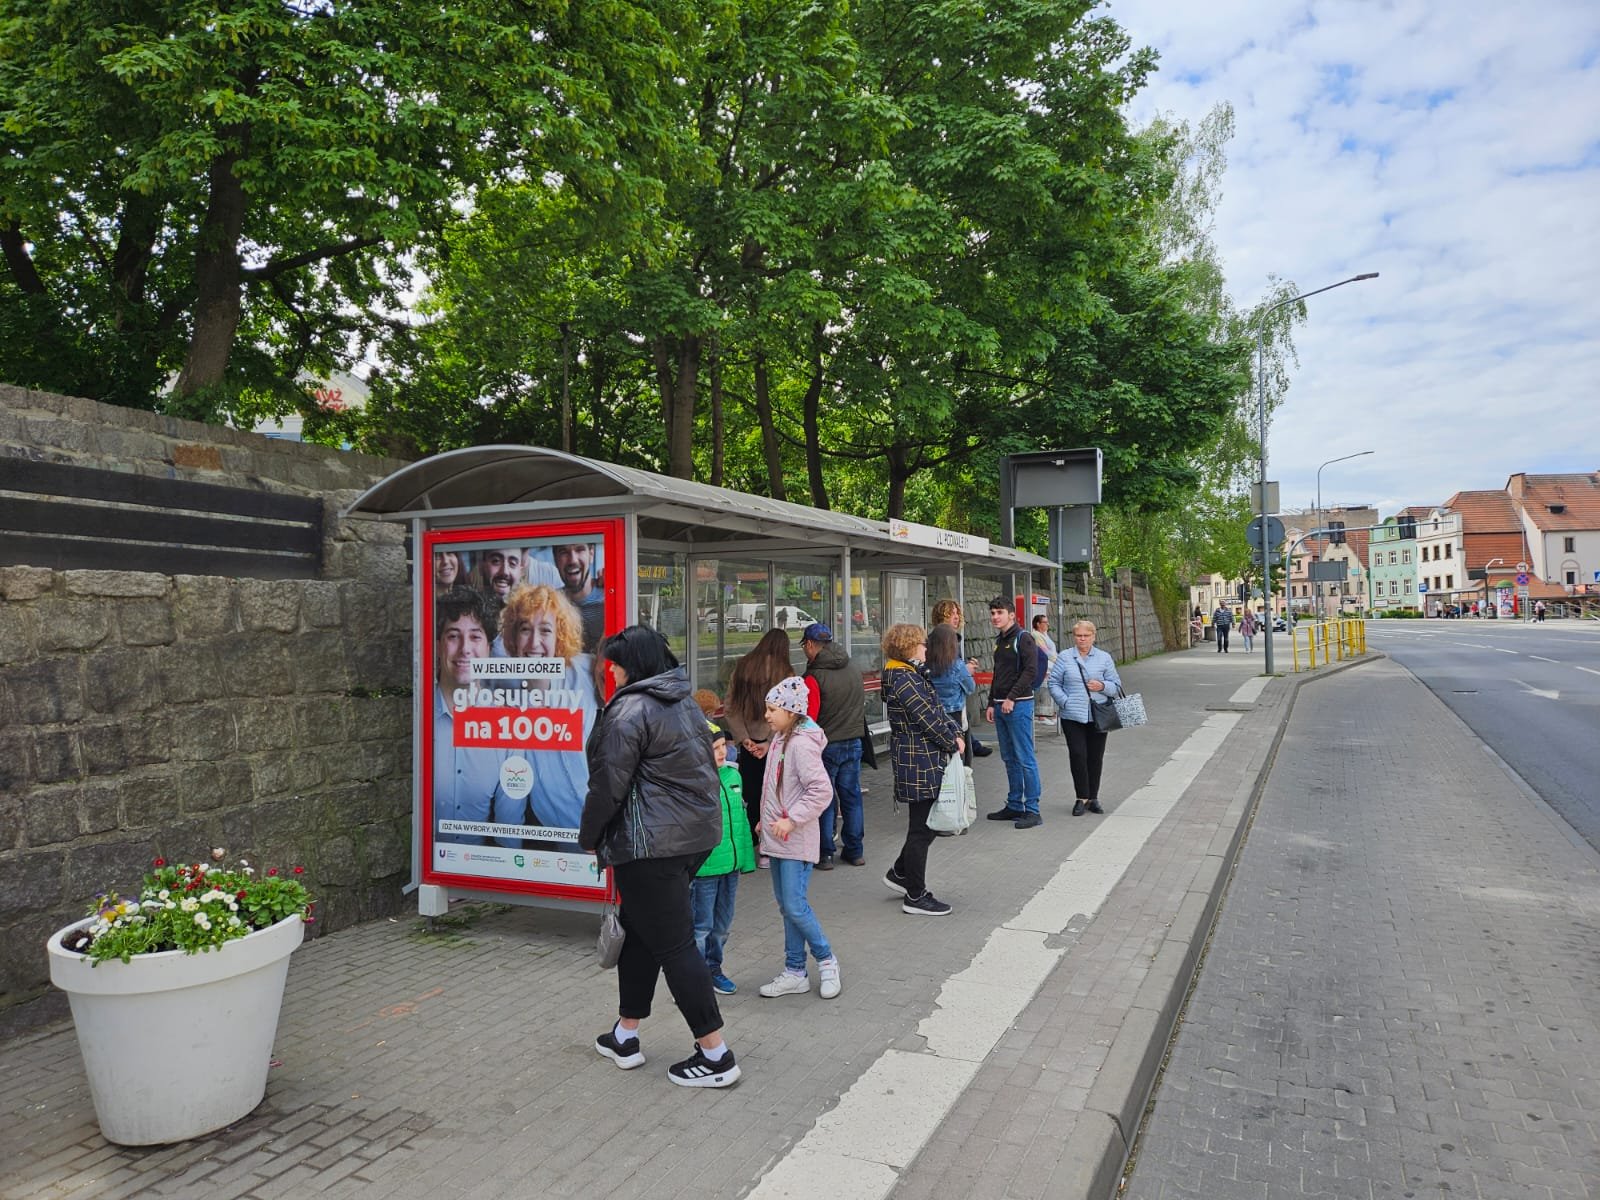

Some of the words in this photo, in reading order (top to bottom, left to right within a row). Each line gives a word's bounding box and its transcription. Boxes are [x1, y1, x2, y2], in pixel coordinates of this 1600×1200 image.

[473, 663, 483, 673] W
[484, 663, 526, 674] JELENIEJ
[527, 661, 562, 674] GÓRZE
[453, 680, 584, 714] głosujemy
[464, 720, 492, 739] na
[498, 716, 572, 741] 100%
[453, 823, 463, 831] NA
[492, 826, 521, 836] WYBIERZ
[521, 829, 553, 839] SWOJEGO
